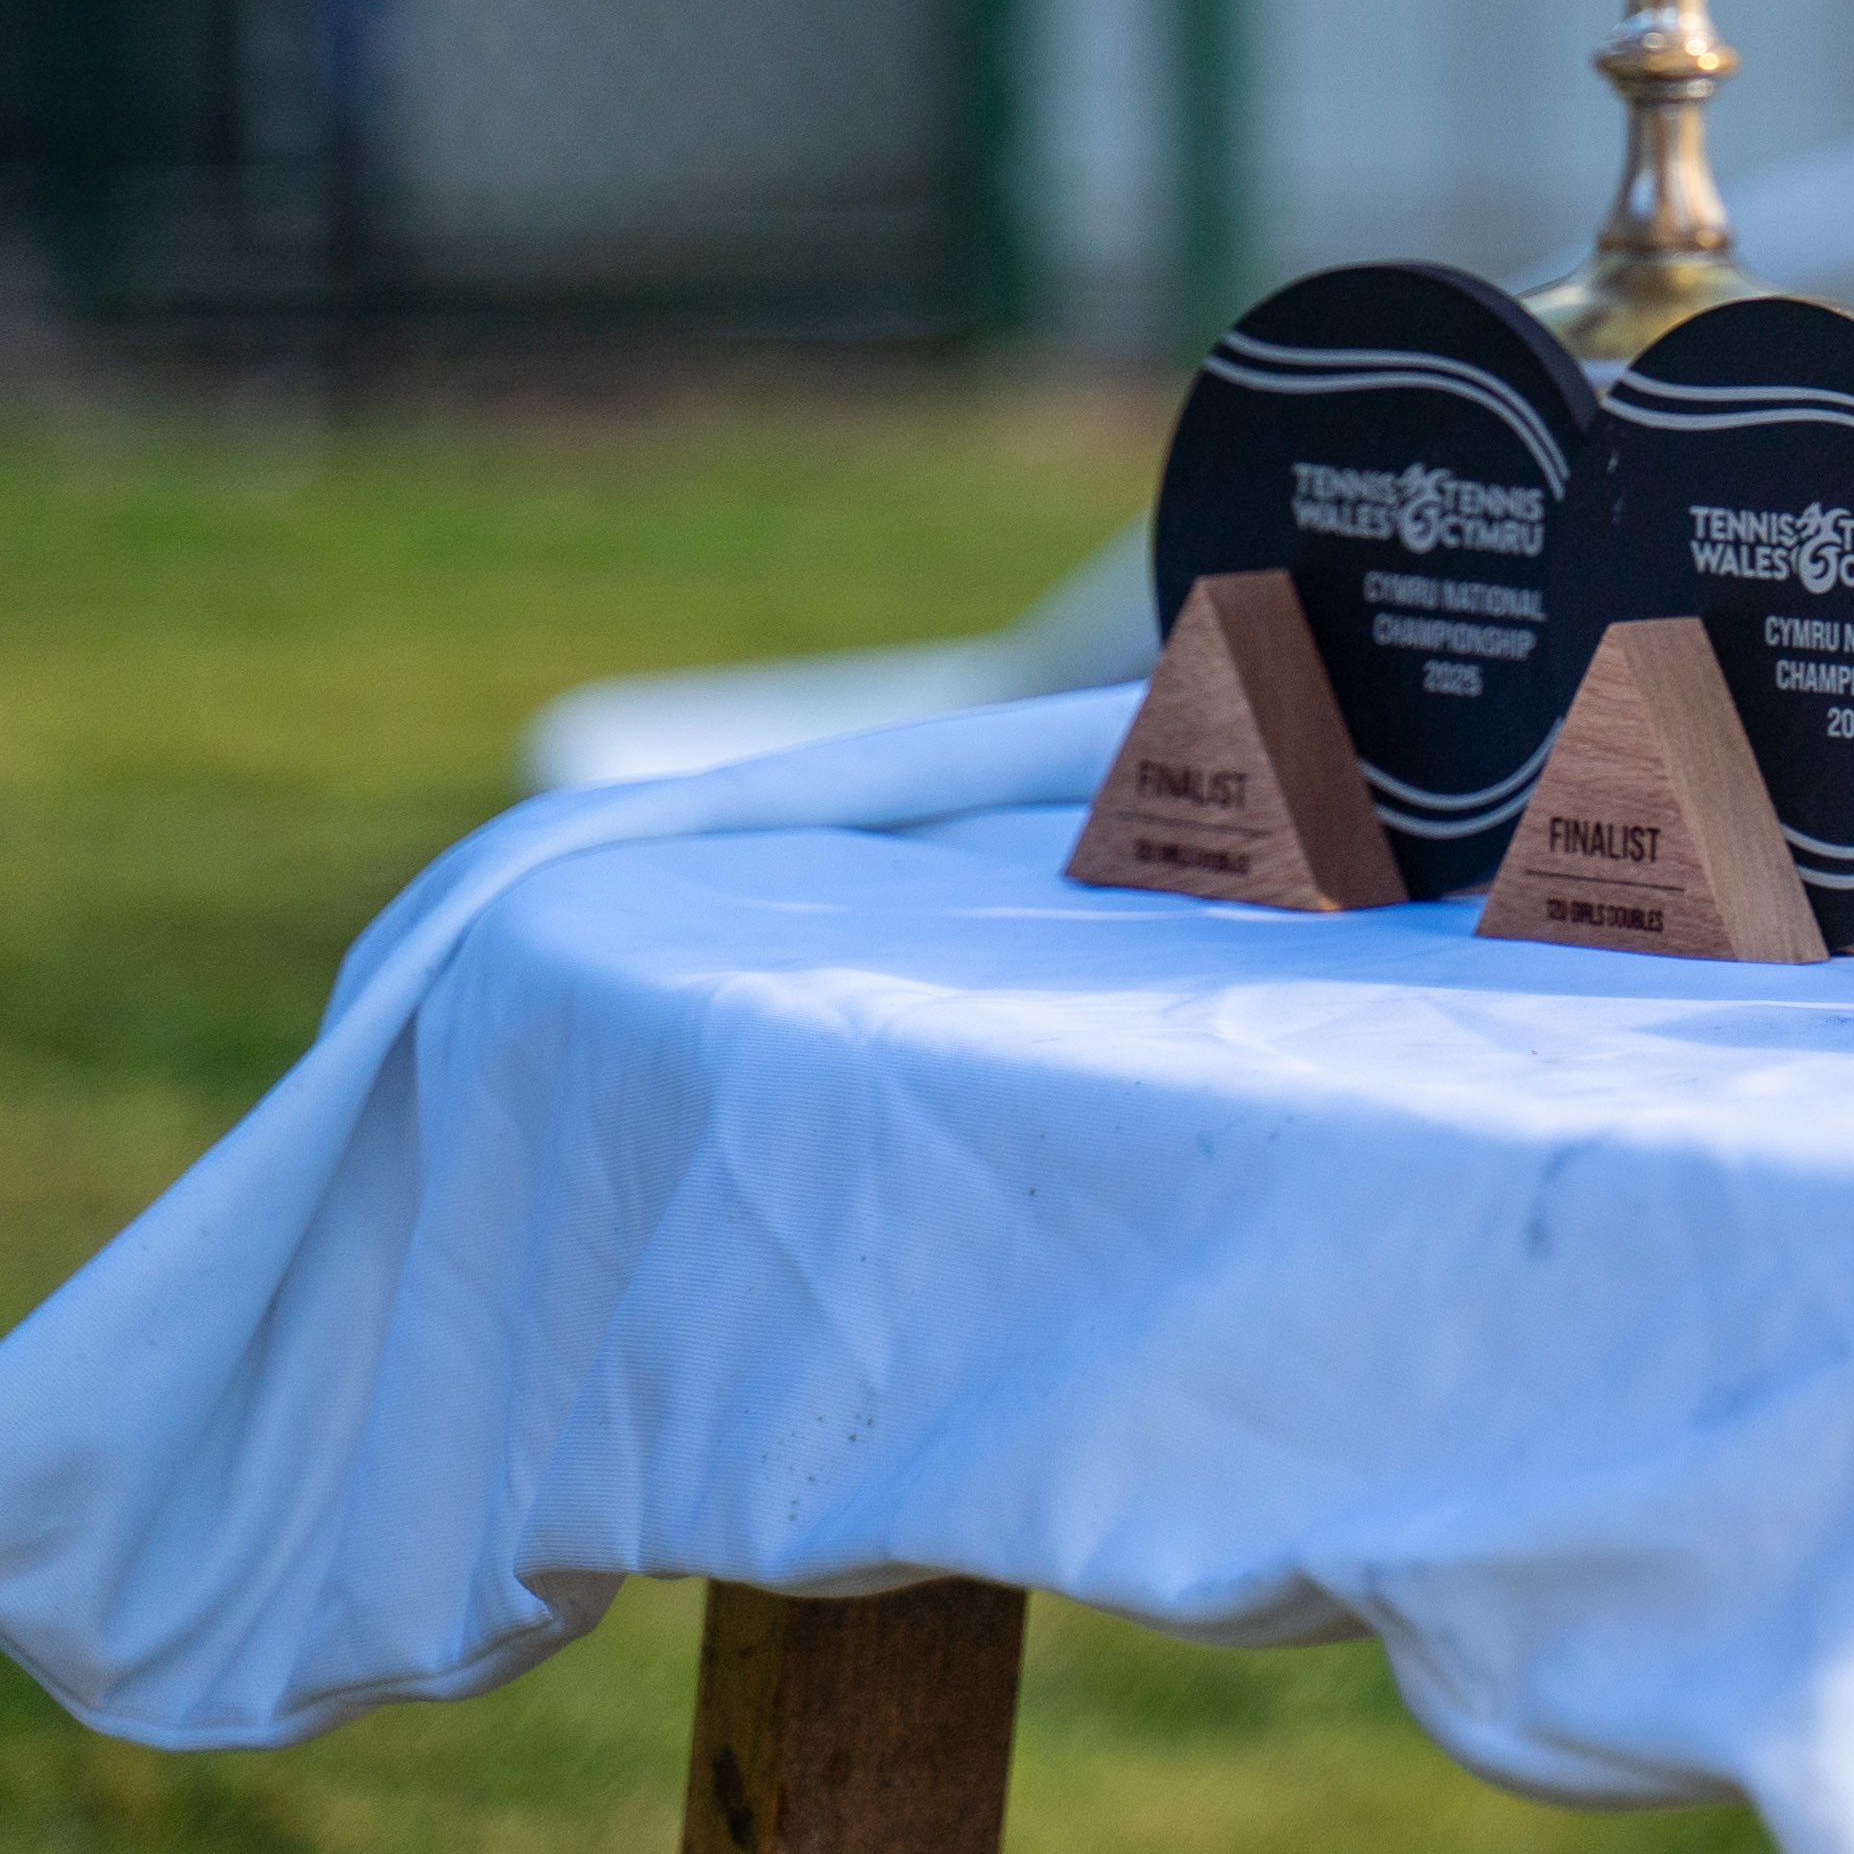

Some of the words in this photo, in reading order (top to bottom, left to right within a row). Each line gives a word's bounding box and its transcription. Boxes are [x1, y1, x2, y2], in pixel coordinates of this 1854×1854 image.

[1291, 462, 1399, 507] TENNIS
[1440, 479, 1545, 521] TENNIS
[1292, 500, 1394, 541] WALES
[1439, 512, 1545, 558] CYMRU
[1689, 505, 1798, 547] TENNIS
[1690, 540, 1790, 582] WALES
[1363, 570, 1440, 610] CYMRU
[1442, 578, 1547, 623] NATIONAL
[1372, 612, 1537, 662] CHAMPIONSHIP
[1764, 615, 1841, 652] CYMRU
[1139, 760, 1248, 810] FINALIST
[1550, 814, 1661, 863] FINALIST
